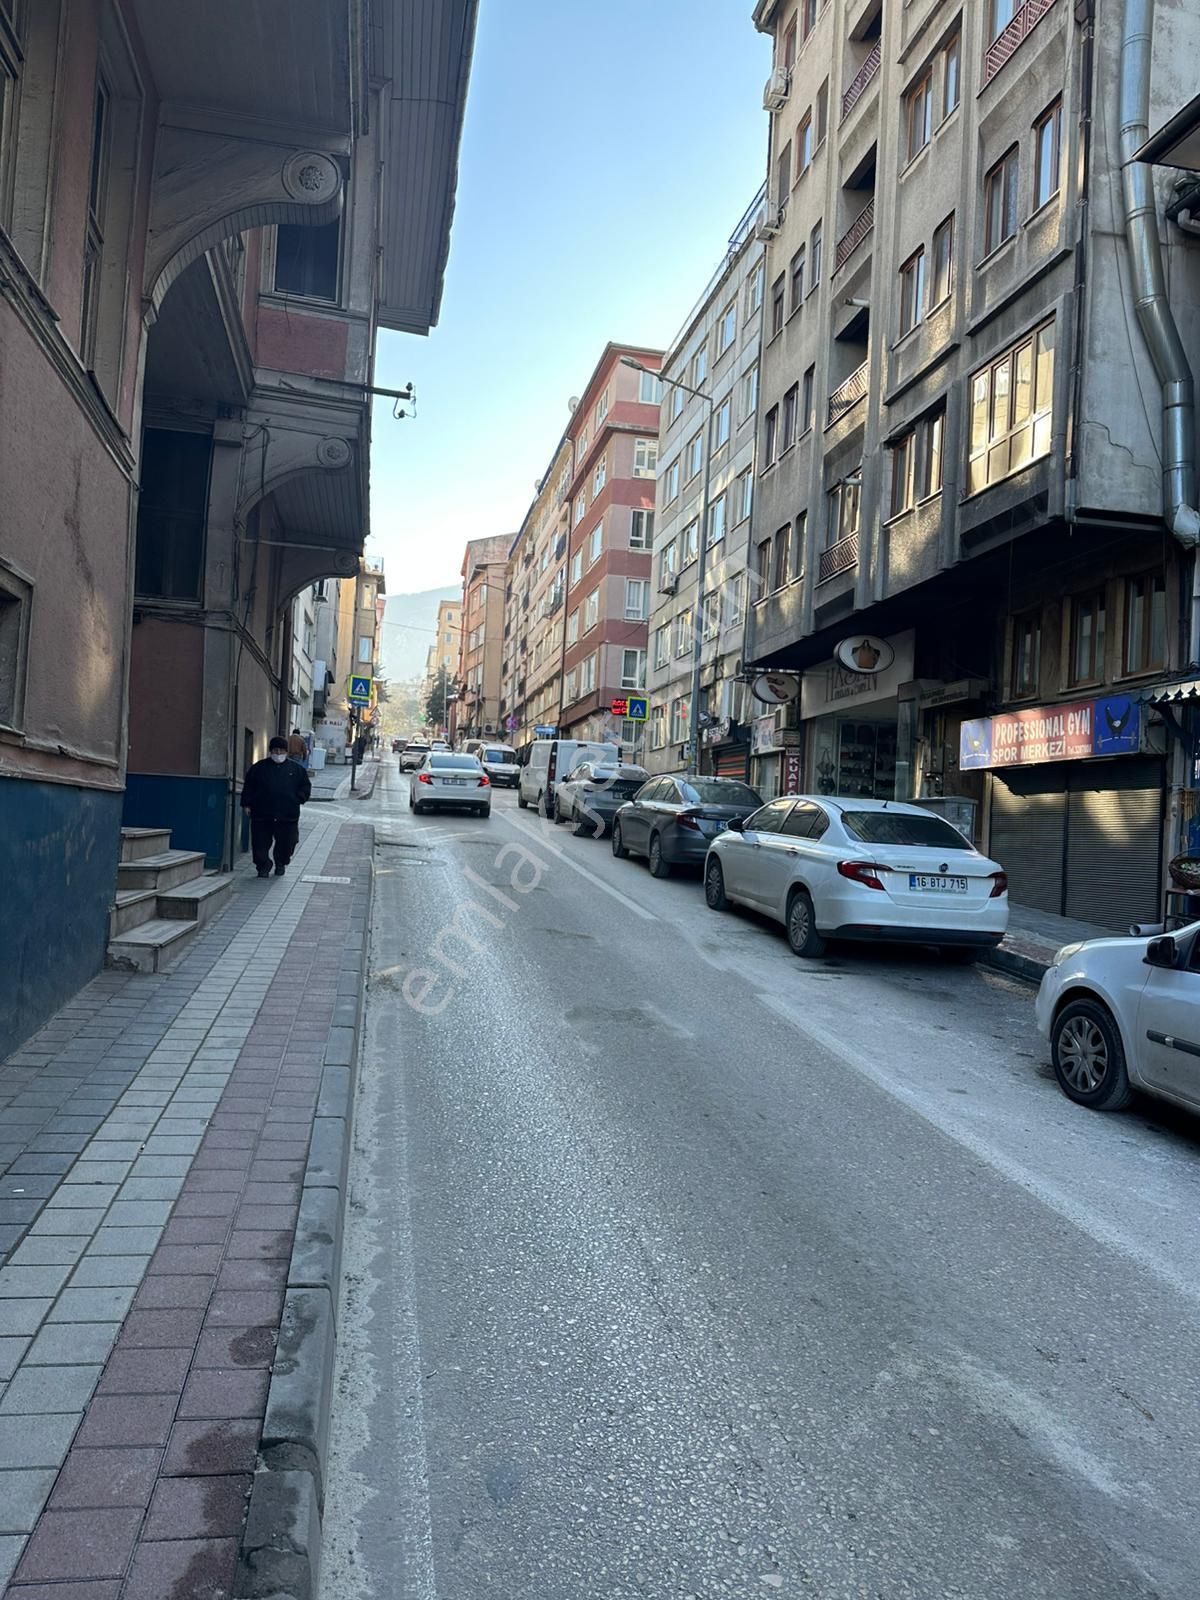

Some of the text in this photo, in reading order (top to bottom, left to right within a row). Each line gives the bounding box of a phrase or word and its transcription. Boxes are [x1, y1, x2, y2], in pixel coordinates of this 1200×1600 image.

[995, 707, 1091, 747] PROFESSIONAL GYM
[992, 747, 1018, 763] SPOR
[1021, 736, 1067, 761] MERKEZİ
[916, 877, 966, 890] 16 BTJ 715
